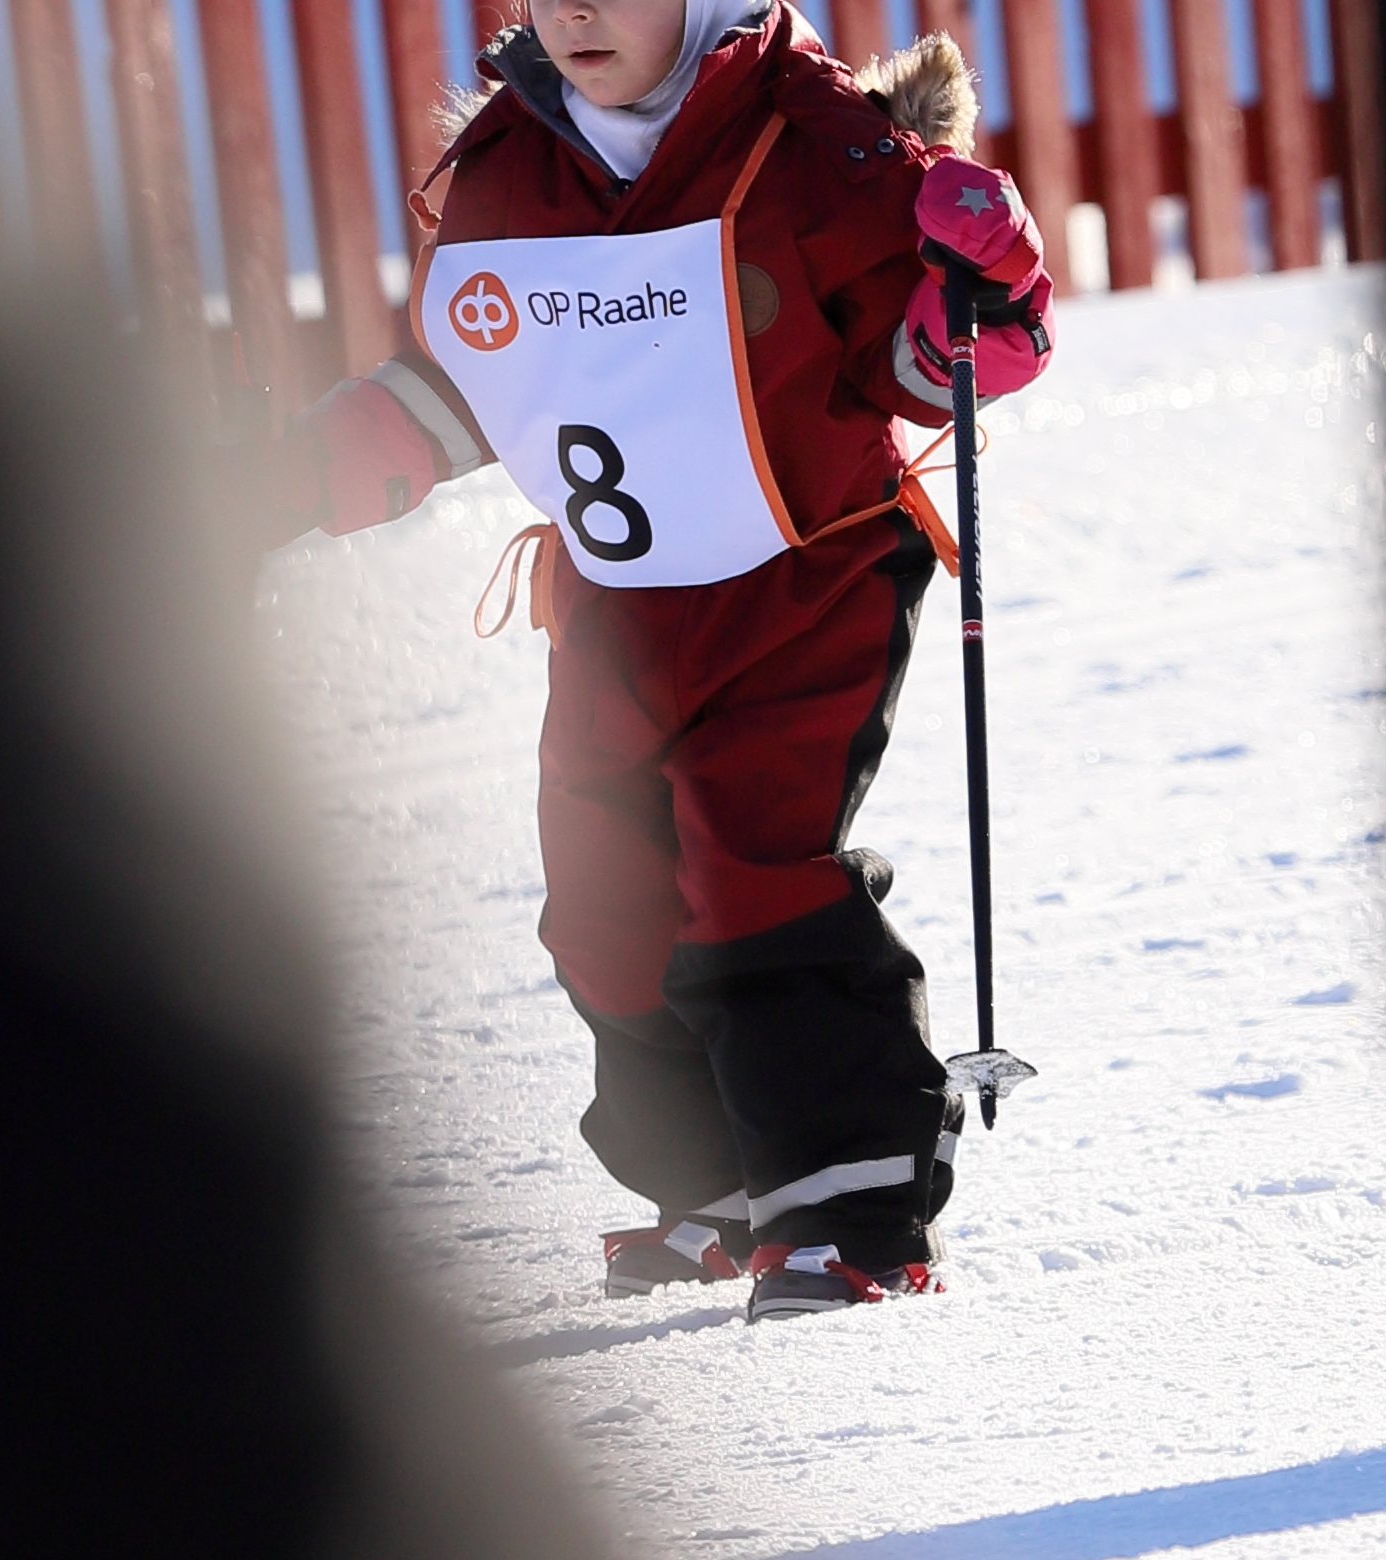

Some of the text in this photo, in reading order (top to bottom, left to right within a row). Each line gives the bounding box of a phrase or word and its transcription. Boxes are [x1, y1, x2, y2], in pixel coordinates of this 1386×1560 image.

[528, 282, 687, 329] OP Raahe
[558, 424, 653, 562] 8
